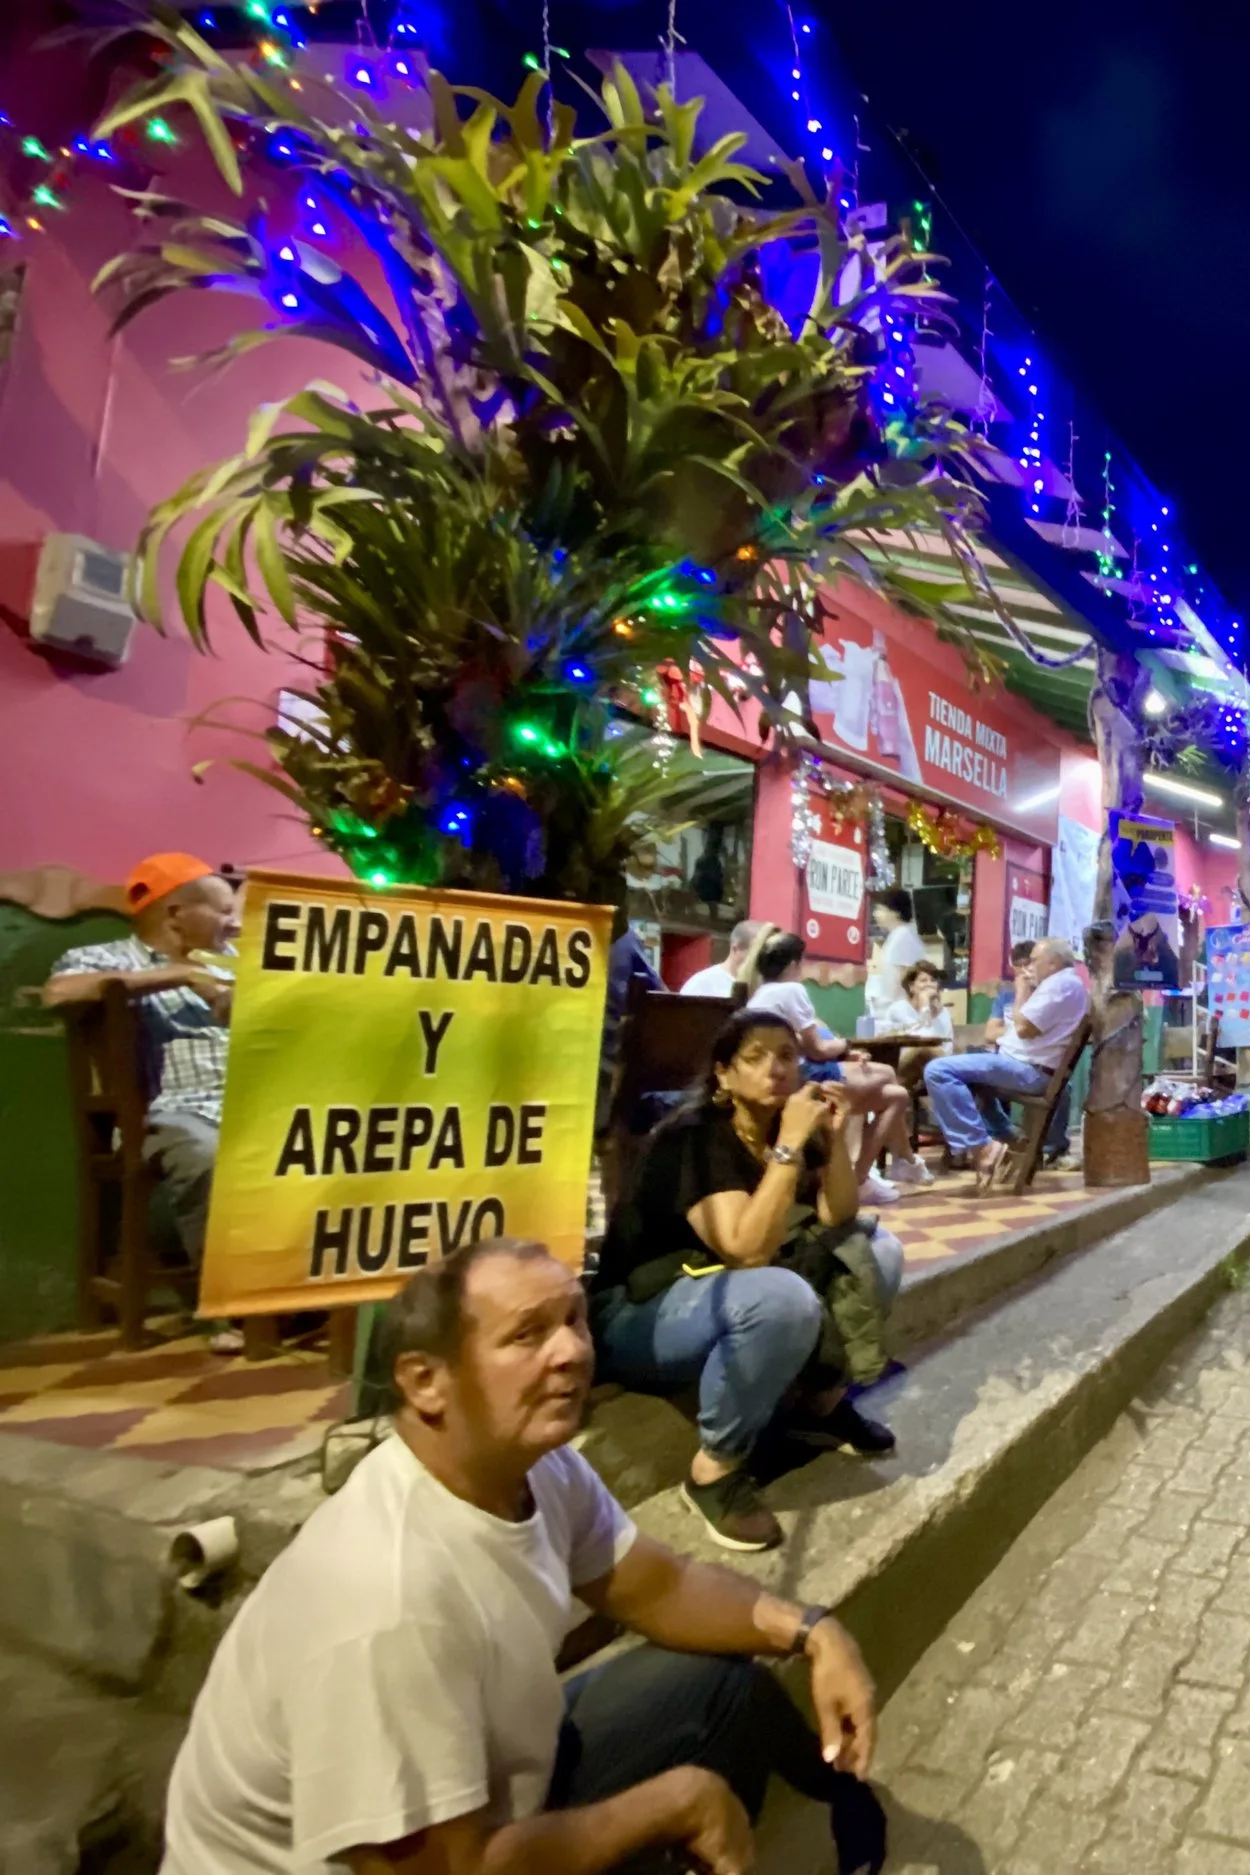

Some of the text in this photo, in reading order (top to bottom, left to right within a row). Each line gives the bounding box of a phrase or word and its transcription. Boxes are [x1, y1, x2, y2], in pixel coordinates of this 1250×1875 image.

[924, 723, 1008, 800] MARSELLA
[928, 690, 1007, 761] TIENDA MIXTA
[809, 858, 829, 892] RON
[262, 903, 593, 988] EMPANADAS
[418, 1010, 455, 1075] Y
[274, 1103, 548, 1177] AREPA DE
[309, 1196, 506, 1277] HUEVO
